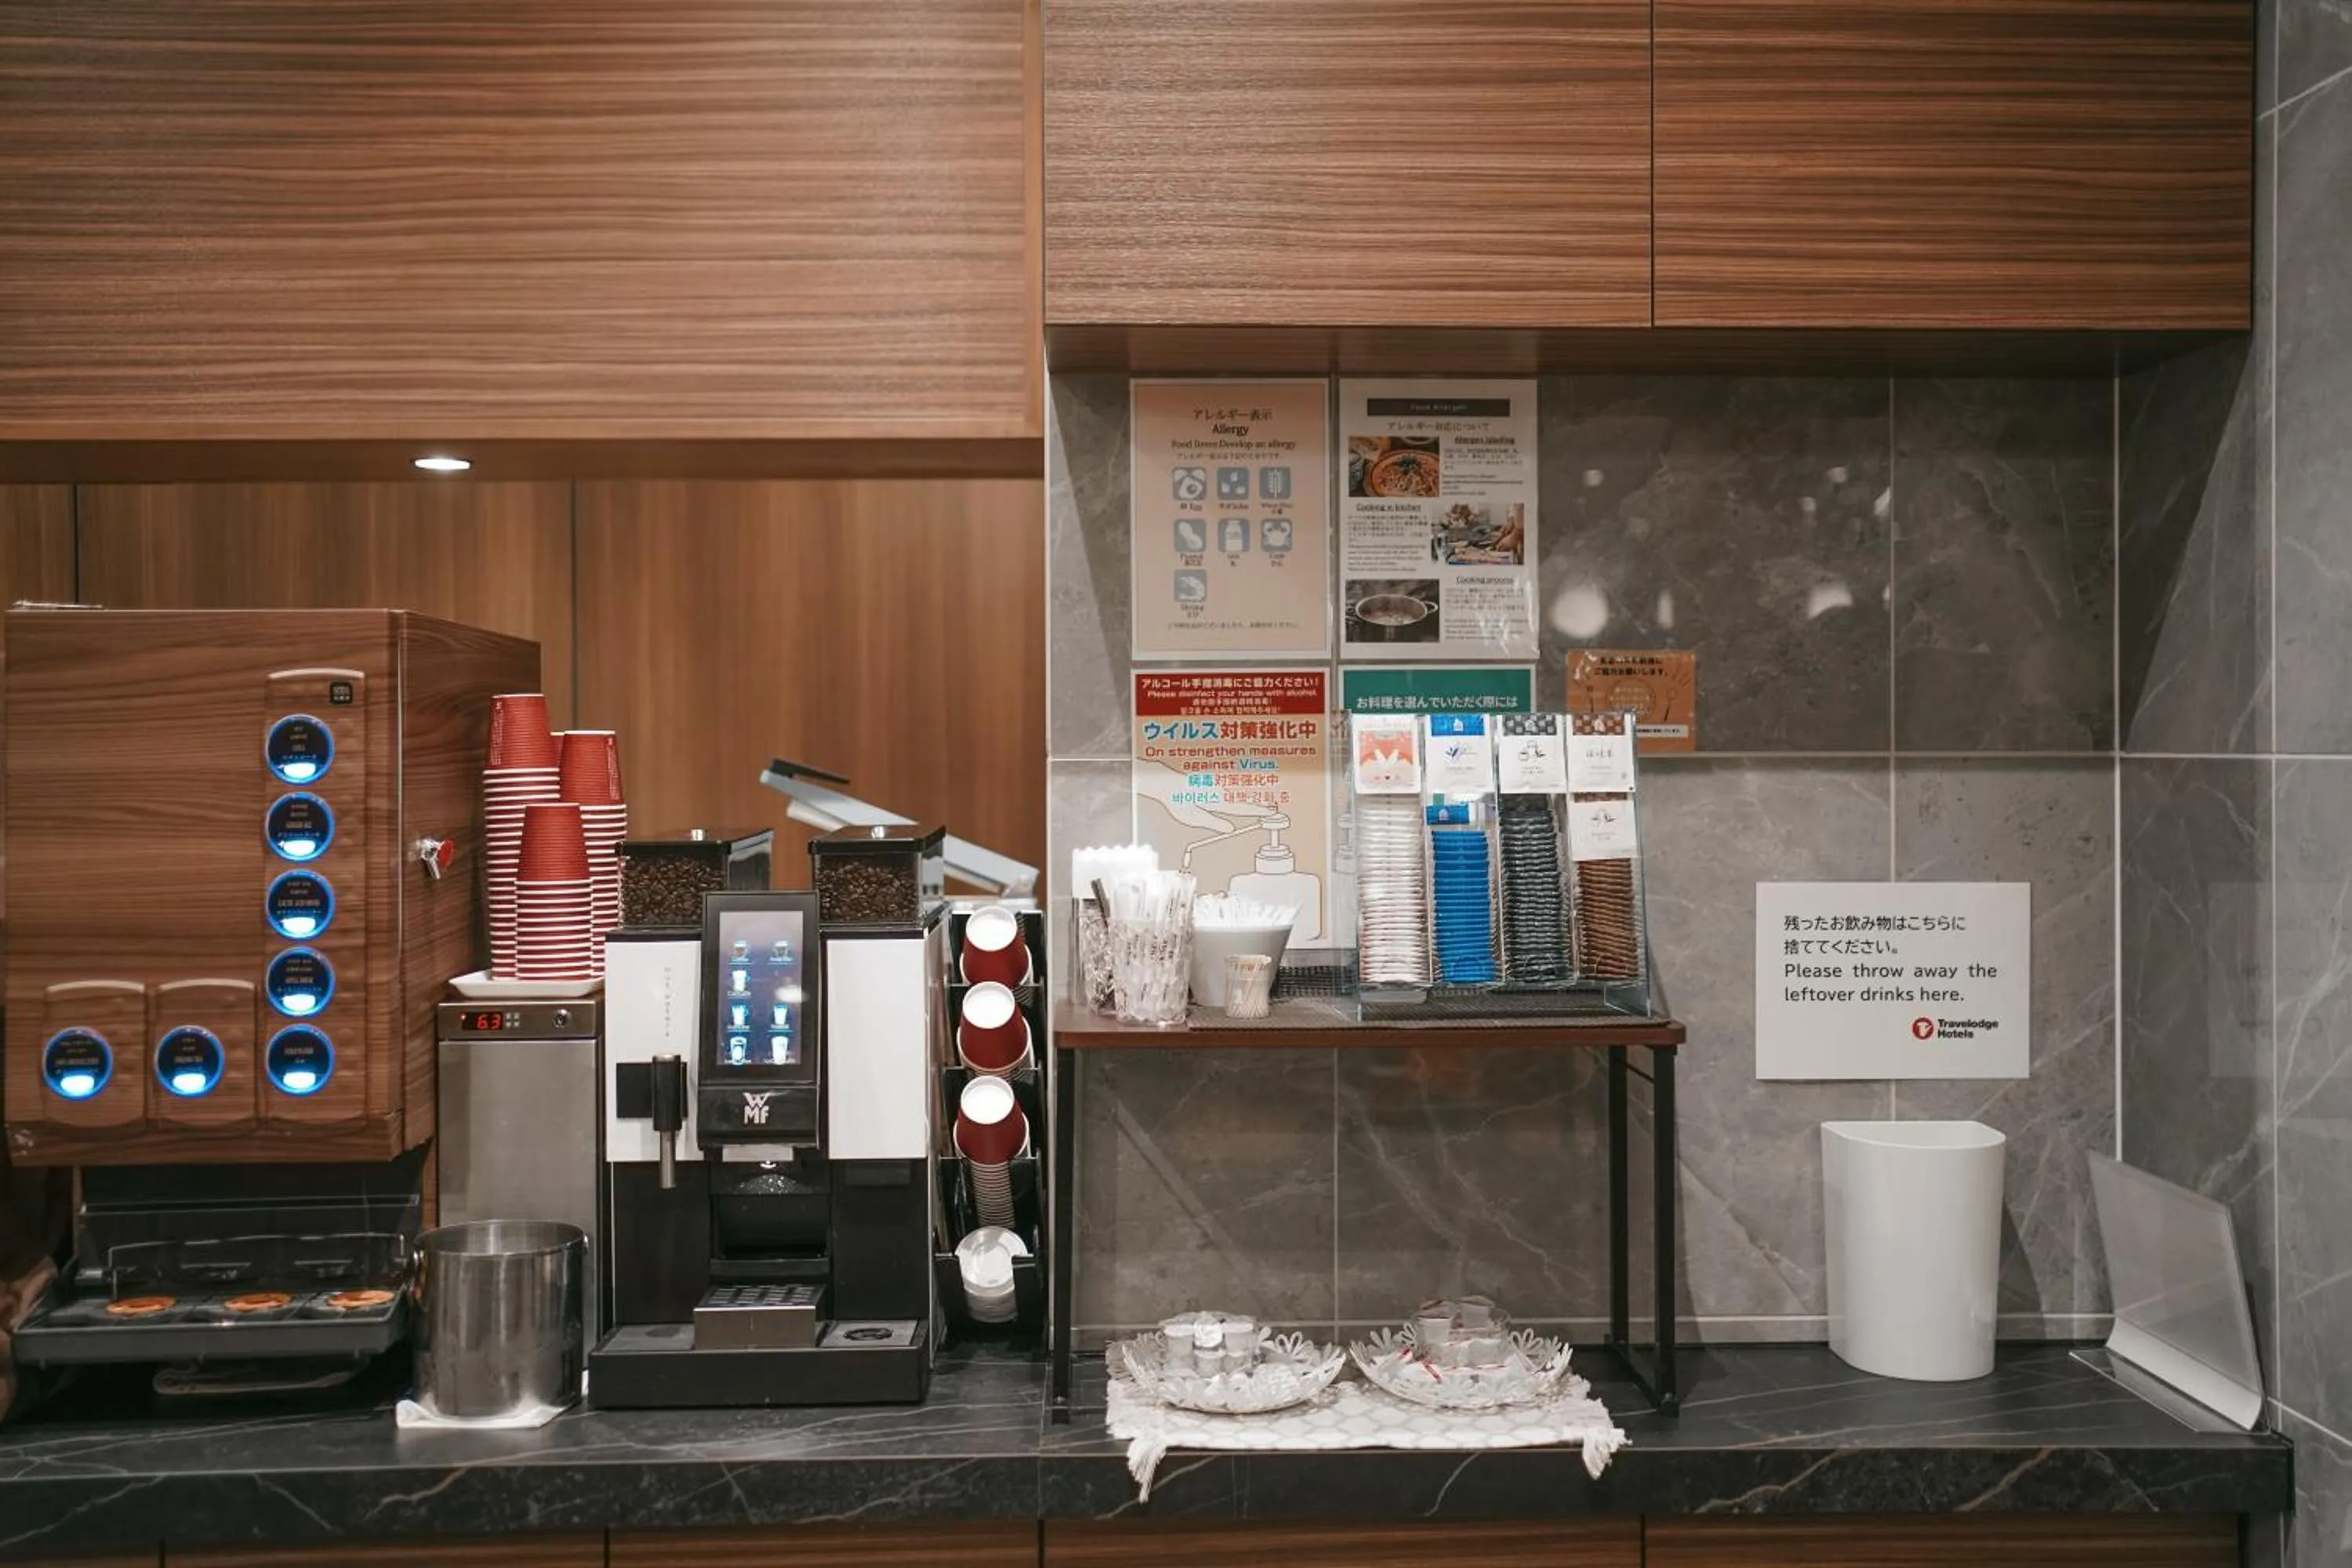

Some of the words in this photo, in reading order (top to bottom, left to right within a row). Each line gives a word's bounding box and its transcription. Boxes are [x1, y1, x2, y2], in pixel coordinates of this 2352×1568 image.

[1213, 423, 1249, 436] Allergy
[1356, 695, 1518, 709] お料理を選んでいただく際には
[1143, 720, 1317, 741] ウイルス対策強化中
[1145, 746, 1164, 757] On
[1168, 746, 1246, 758] strengthen
[1249, 746, 1316, 756] measures
[1183, 760, 1236, 771] against
[1239, 758, 1279, 769] Virus.
[1172, 792, 1220, 804] 바이러스
[1784, 915, 1966, 931] 残ったお飲み物はこちらに
[1784, 938, 1899, 955] 捨ててください。
[1784, 964, 1842, 978] Please
[1853, 963, 1904, 978] throw
[1914, 966, 1958, 980] away
[1968, 963, 1998, 978] the
[1784, 986, 1855, 1002] leftover
[1860, 987, 1915, 1002] drinks
[1920, 988, 1965, 1002] here.
[477, 1014, 502, 1029] 63
[1937, 1018, 1998, 1029] Travelodge
[1937, 1029, 1974, 1039] Hotels
[742, 1092, 770, 1124] WMF
